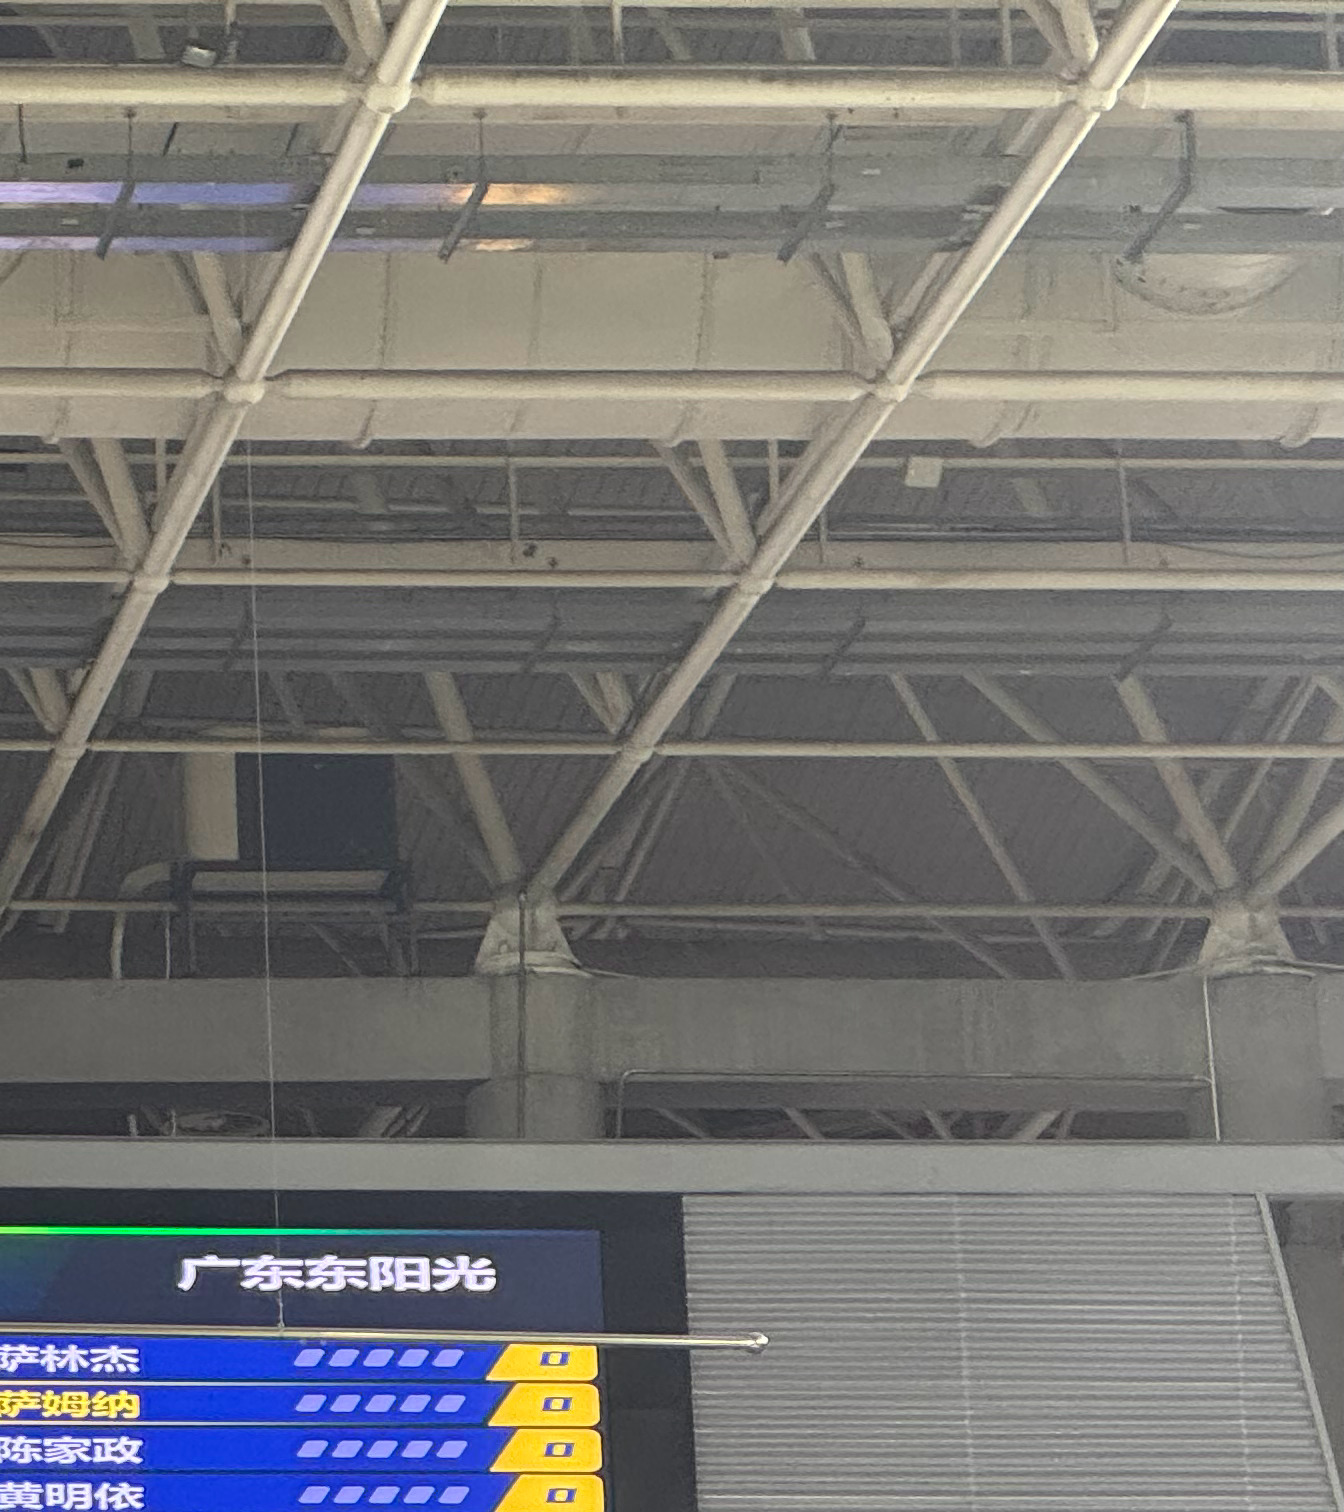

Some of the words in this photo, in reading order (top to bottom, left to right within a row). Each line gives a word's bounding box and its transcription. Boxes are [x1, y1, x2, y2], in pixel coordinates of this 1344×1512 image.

[177, 1254, 497, 1293] 广东东阳光
[540, 1351, 569, 1366] 0
[543, 1396, 572, 1412] 0
[545, 1442, 573, 1457] 0
[547, 1488, 575, 1503] 0
